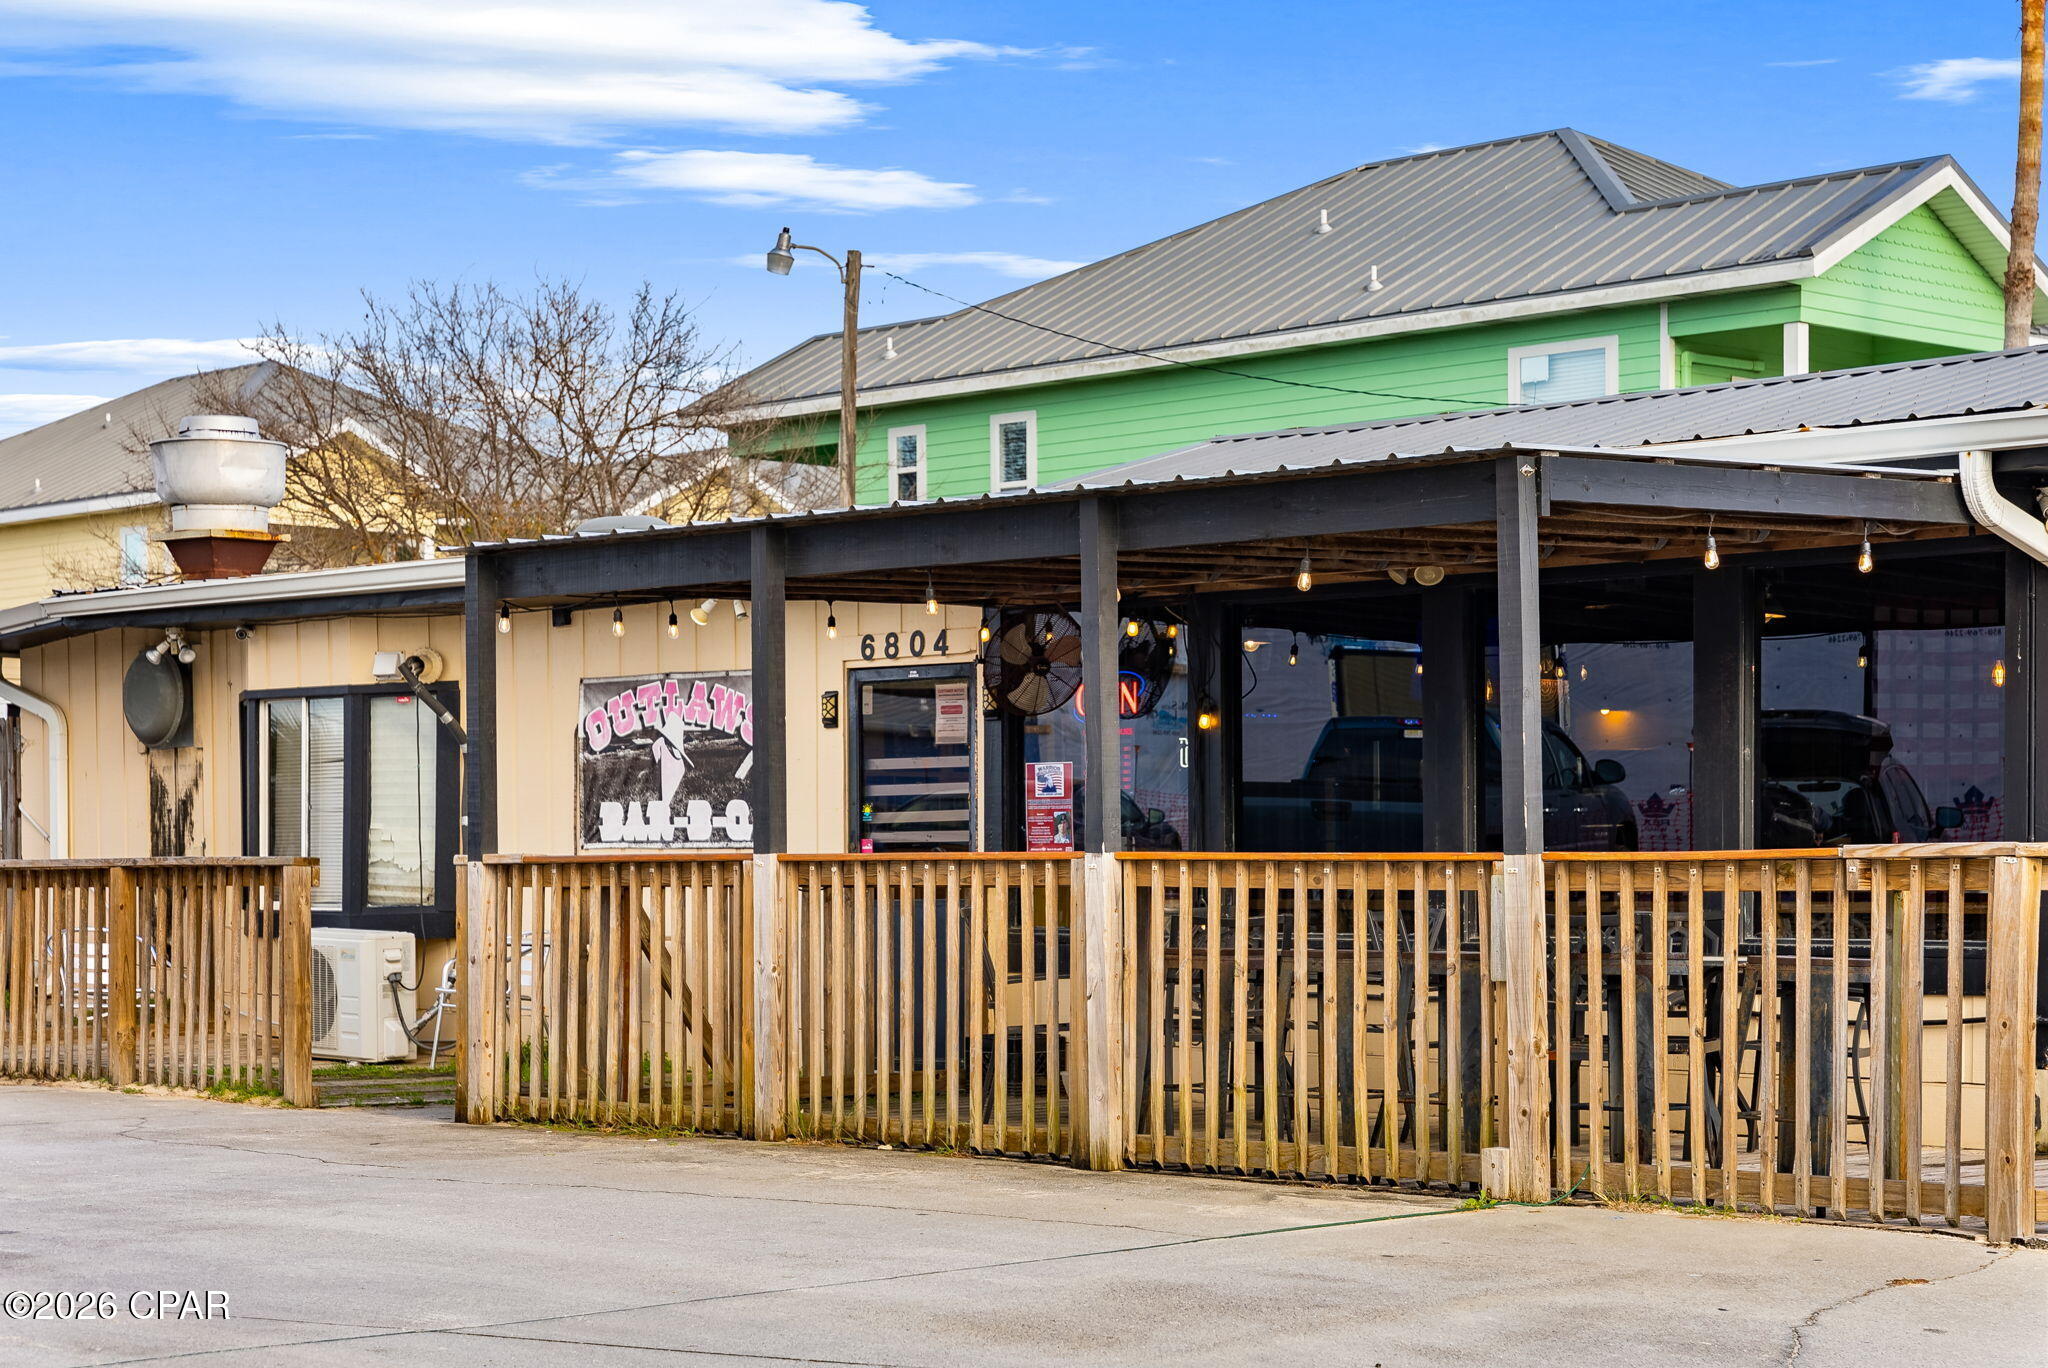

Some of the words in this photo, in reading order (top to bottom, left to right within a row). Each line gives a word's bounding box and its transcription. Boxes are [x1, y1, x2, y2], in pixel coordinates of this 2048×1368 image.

[861, 628, 949, 661] 6804
[1075, 682, 1138, 716] ON
[599, 800, 753, 842] BAR-B-Q
